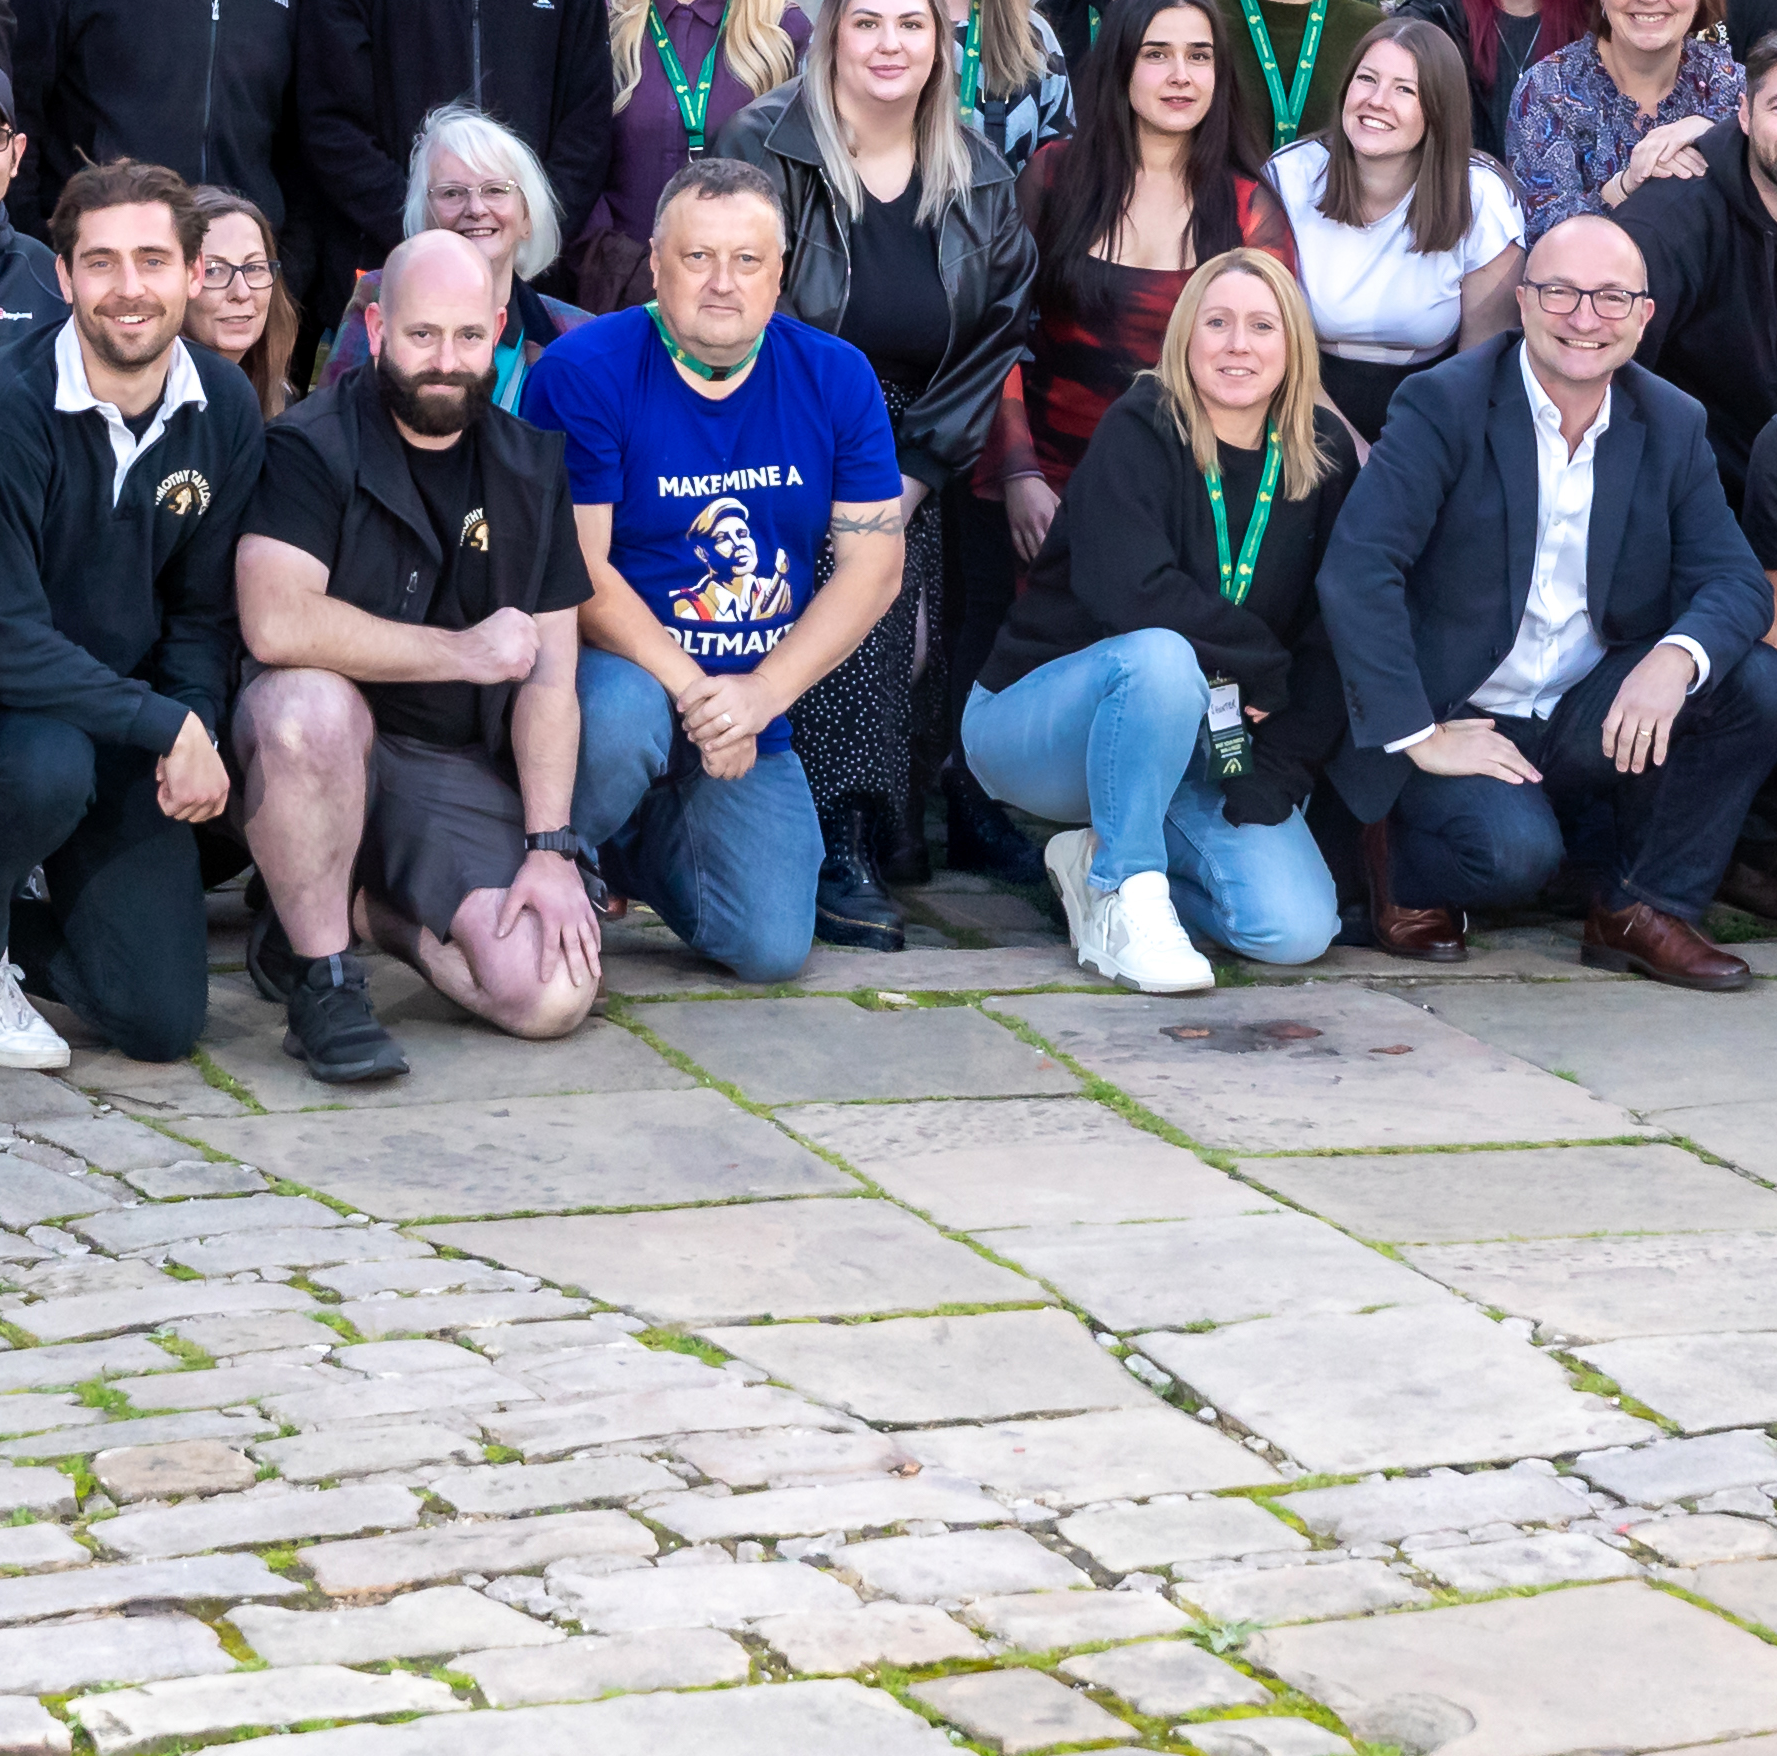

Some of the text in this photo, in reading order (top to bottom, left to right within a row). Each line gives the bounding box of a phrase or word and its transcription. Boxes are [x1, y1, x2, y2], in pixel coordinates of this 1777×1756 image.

[657, 465, 803, 498] MAKE MINE A
